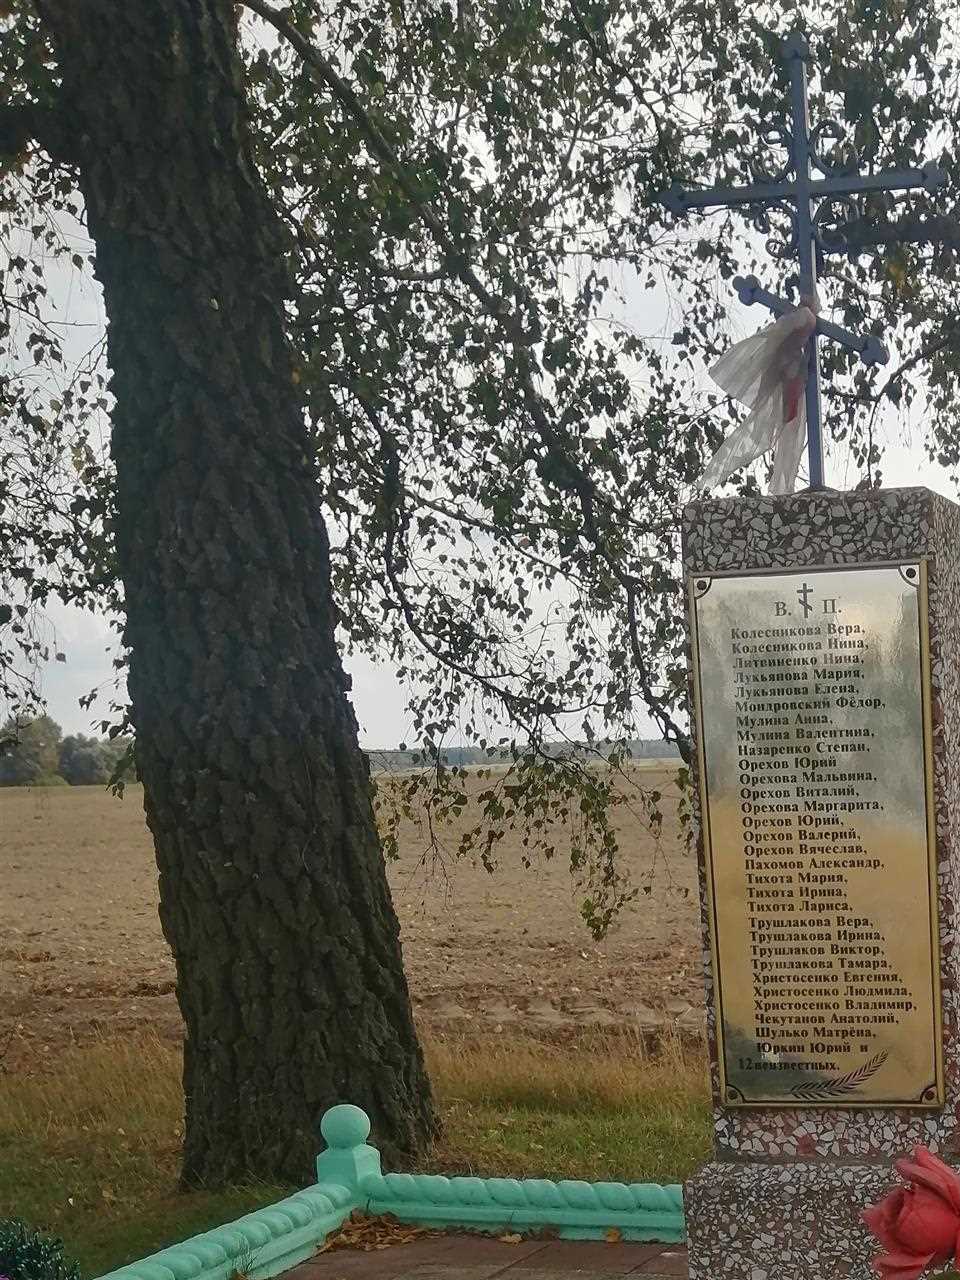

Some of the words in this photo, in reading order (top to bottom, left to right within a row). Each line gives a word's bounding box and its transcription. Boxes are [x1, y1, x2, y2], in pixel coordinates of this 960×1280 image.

[775, 602, 792, 617] В.
[822, 599, 842, 614] П.
[731, 626, 820, 639] Колесникова
[827, 623, 866, 635] Вера,
[732, 641, 822, 654] Колесникова
[828, 638, 869, 650] Нина,
[733, 656, 817, 669] Литвиненко
[823, 653, 864, 666] Нина,
[734, 672, 807, 685] Лукьянова
[813, 669, 865, 681] Мария,
[735, 687, 809, 699] Лукьянова
[814, 684, 859, 696] Елена,
[736, 699, 831, 714] Мондровский
[836, 696, 886, 710] Фёдор,
[736, 716, 789, 728] Мулина
[795, 714, 832, 726] Анна,
[737, 730, 789, 743] Мулина
[796, 727, 875, 740] Валентина,
[738, 744, 811, 758] Назаренко
[817, 742, 870, 755] Степан,
[739, 759, 789, 772] Орехов
[795, 756, 837, 770] Юрий
[740, 774, 797, 787] Орехова
[803, 771, 877, 783] Мальвина,
[740, 788, 790, 801] Орехов
[796, 785, 859, 798] Виталий,
[741, 803, 798, 816] Орехова
[804, 800, 884, 813] Маргарита,
[742, 817, 792, 830] Орехов
[798, 813, 844, 827] Юрий,
[743, 830, 793, 844] Орехов
[799, 827, 861, 842] Валерий,
[744, 845, 794, 858] Орехов
[800, 843, 867, 856] Вячеслав,
[745, 859, 804, 871] Пахомов
[809, 857, 885, 872] Александр,
[746, 873, 793, 885] Тихота
[798, 872, 848, 886] Мария,
[747, 887, 794, 899] Тихота
[799, 886, 847, 900] Ирина,
[747, 901, 795, 913] Тихота
[799, 901, 853, 914] Лариса,
[748, 917, 831, 930] Трушлакова
[836, 916, 874, 929] Вера,
[749, 931, 832, 944] Трушлакова
[837, 930, 885, 943] Ирина,
[751, 945, 825, 958] Трушлаков
[830, 944, 885, 957] Виктор,
[751, 958, 833, 971] Трушлакова
[838, 958, 892, 971] Тамара,
[752, 972, 839, 986] Христосенко
[844, 972, 902, 985] Евгения,
[754, 985, 839, 999] Христосенко
[844, 985, 912, 999] Людмила,
[754, 1000, 840, 1013] Христосенко
[845, 1000, 917, 1014] Владимир,
[755, 1014, 826, 1027] Чекутанов
[830, 1012, 899, 1026] Анатолий,
[755, 1027, 809, 1040] Шулько
[814, 1026, 876, 1040] Матрёна,
[757, 1043, 805, 1055] Юркин
[810, 1041, 851, 1055] Юрий
[859, 1045, 868, 1053] и
